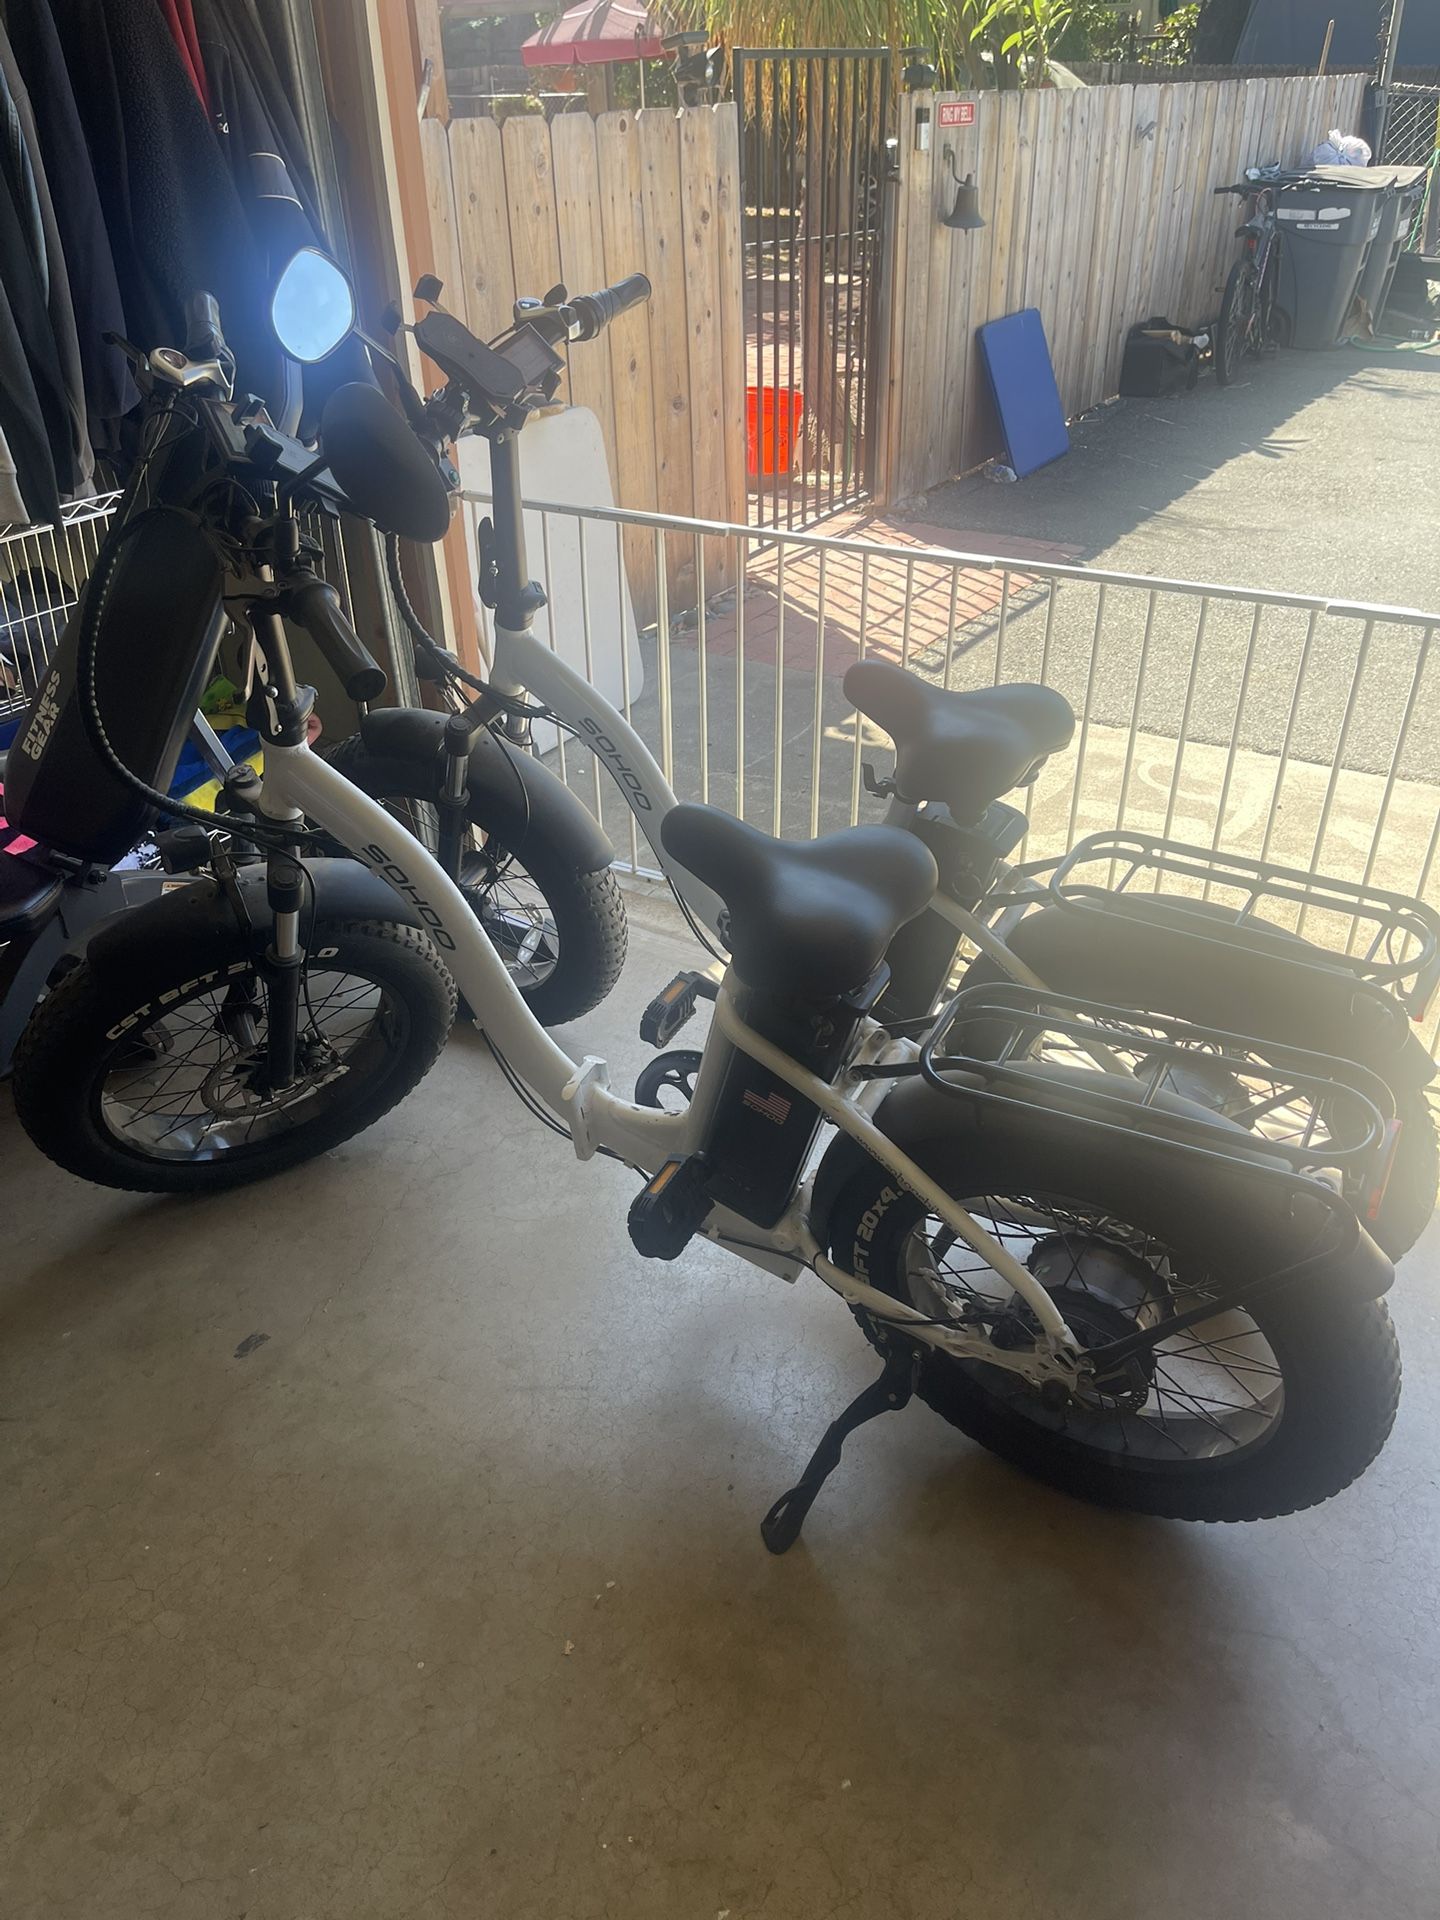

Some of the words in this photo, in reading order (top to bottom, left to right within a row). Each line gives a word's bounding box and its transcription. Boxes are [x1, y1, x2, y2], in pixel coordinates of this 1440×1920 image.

[22, 670, 60, 755] FITNESS
[30, 702, 60, 760] GEAR
[579, 717, 652, 811] SOHOO
[362, 844, 456, 950] SOHOO
[106, 1003, 151, 1040] CST
[159, 970, 219, 1005] BFT
